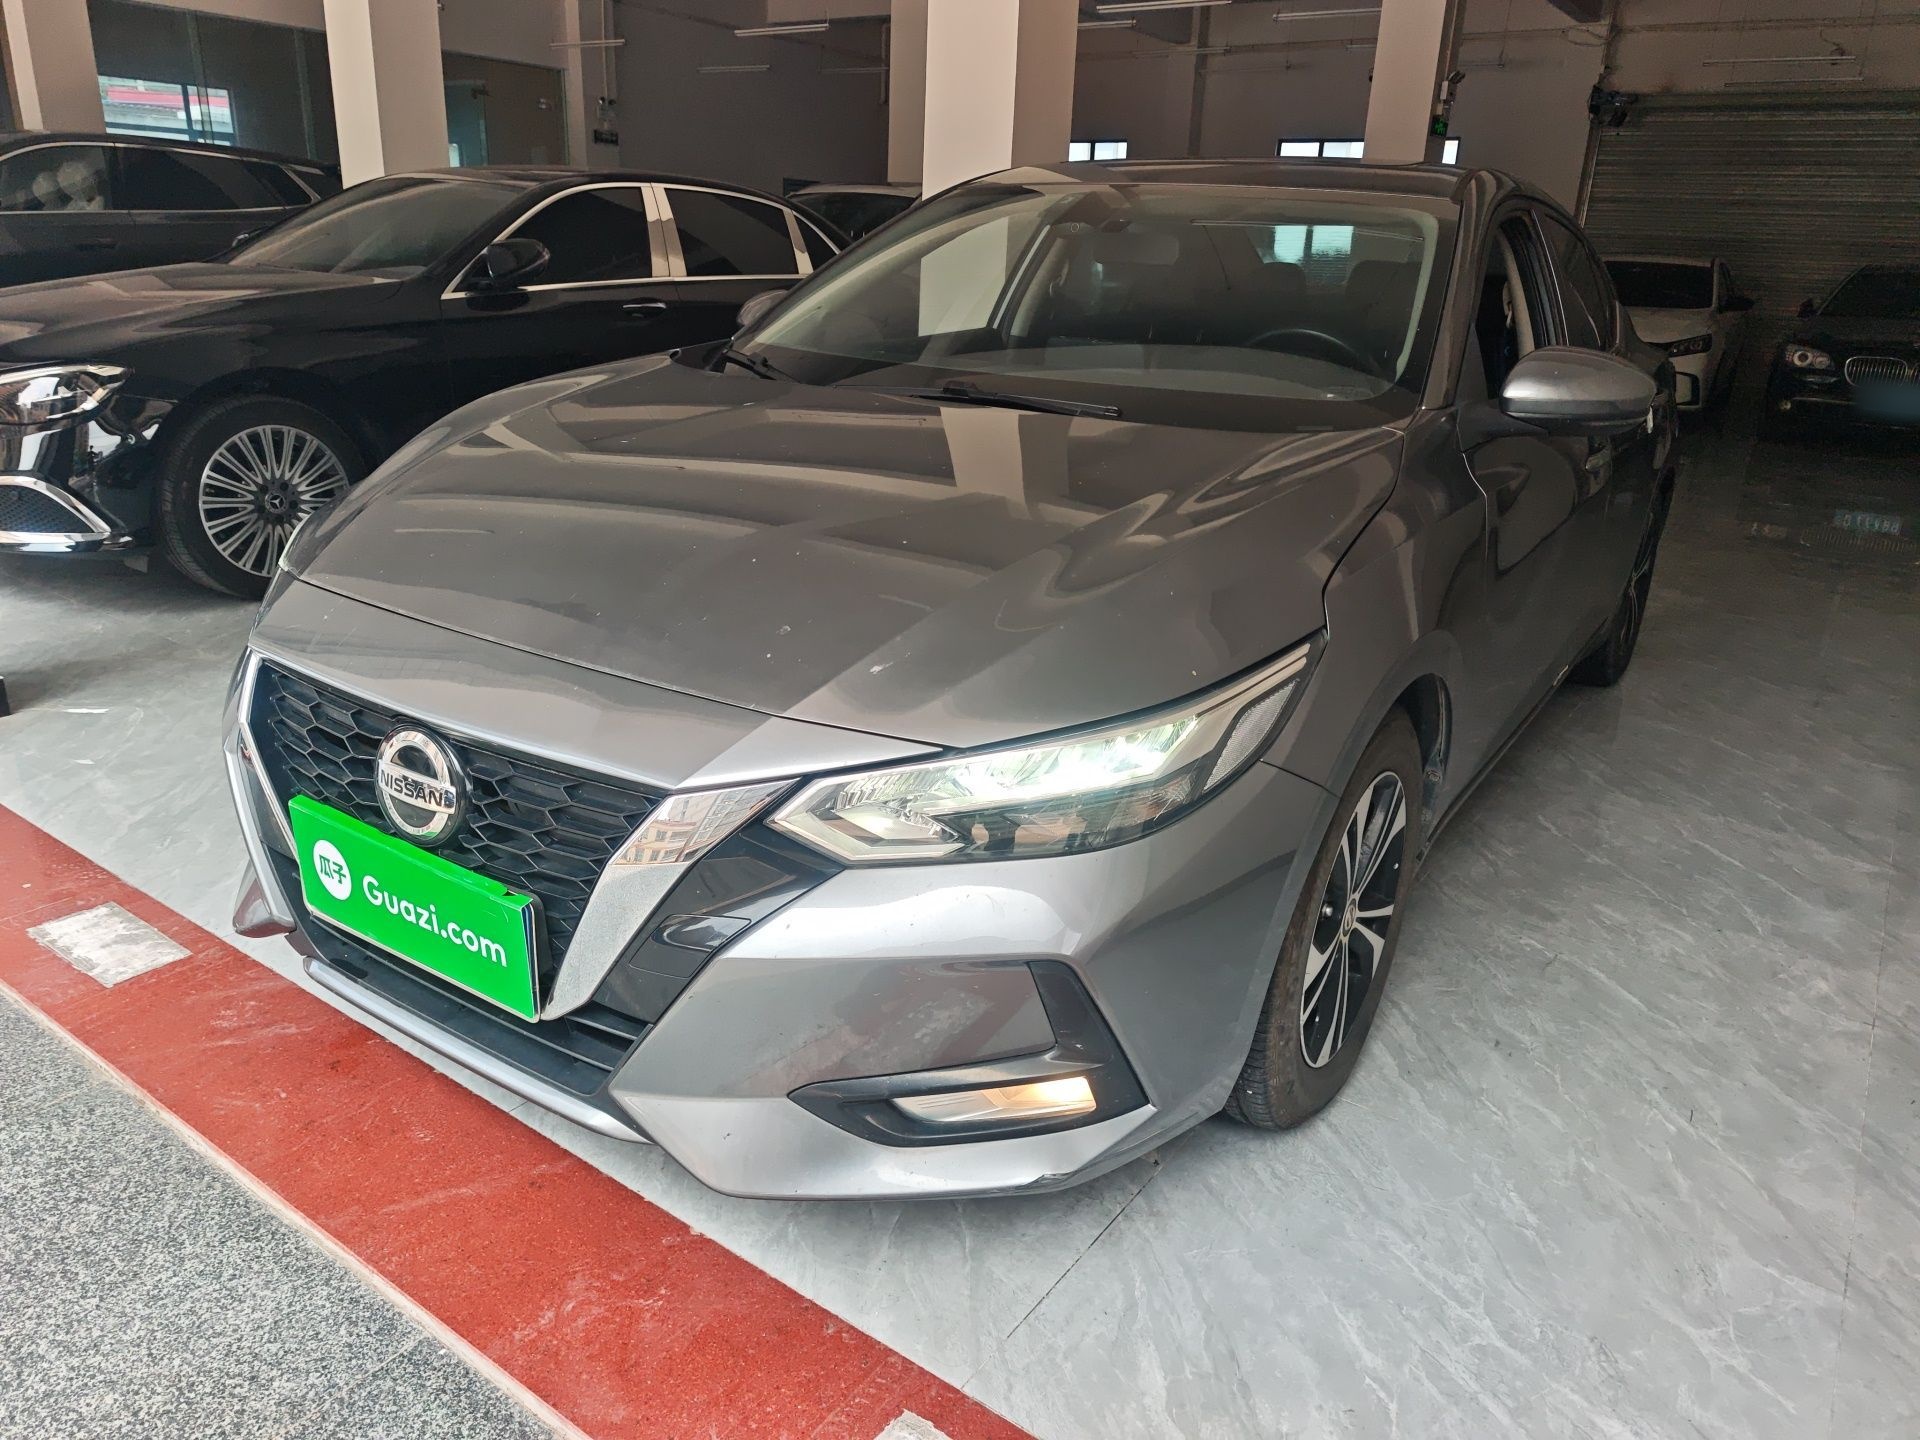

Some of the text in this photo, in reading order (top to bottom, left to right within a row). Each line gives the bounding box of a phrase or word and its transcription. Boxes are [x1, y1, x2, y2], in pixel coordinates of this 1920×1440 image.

[381, 769, 443, 807] NISSAN
[318, 854, 347, 885] 瓜子
[362, 875, 508, 968] Guazi.com
